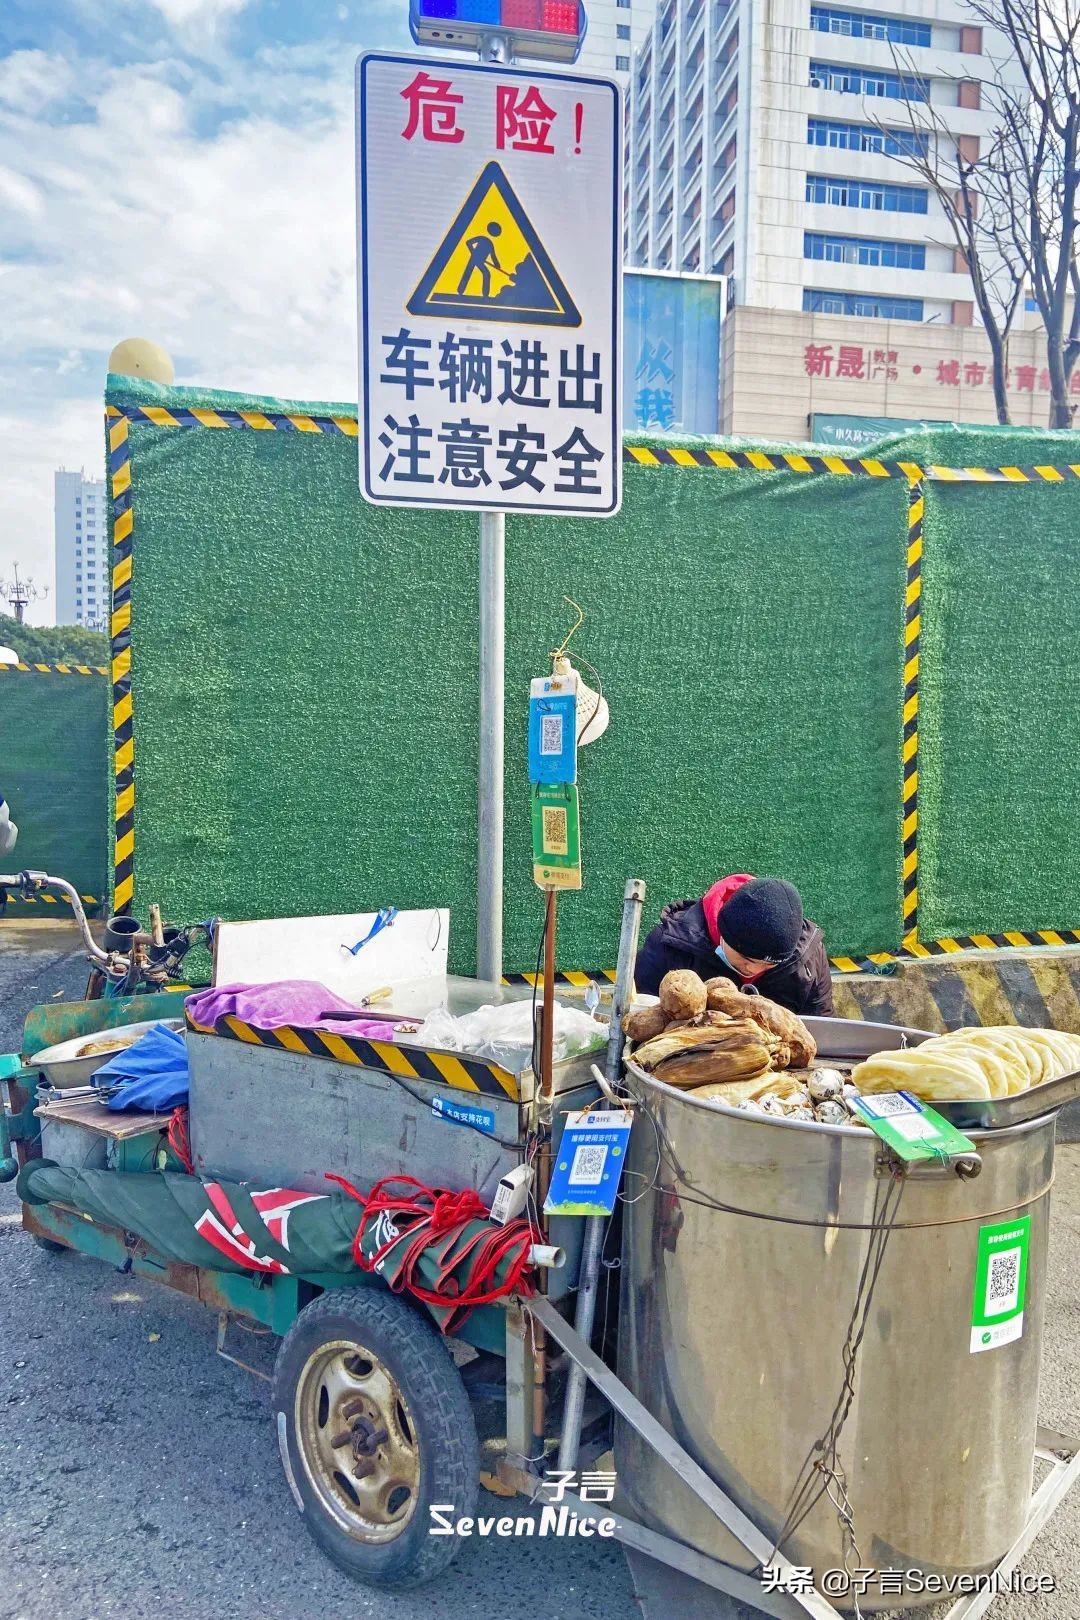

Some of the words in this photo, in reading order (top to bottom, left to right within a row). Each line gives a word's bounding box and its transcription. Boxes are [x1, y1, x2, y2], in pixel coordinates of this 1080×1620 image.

[379, 327, 603, 414] 车辆进出
[804, 343, 865, 379] 新晟
[378, 413, 605, 495] 注意安全
